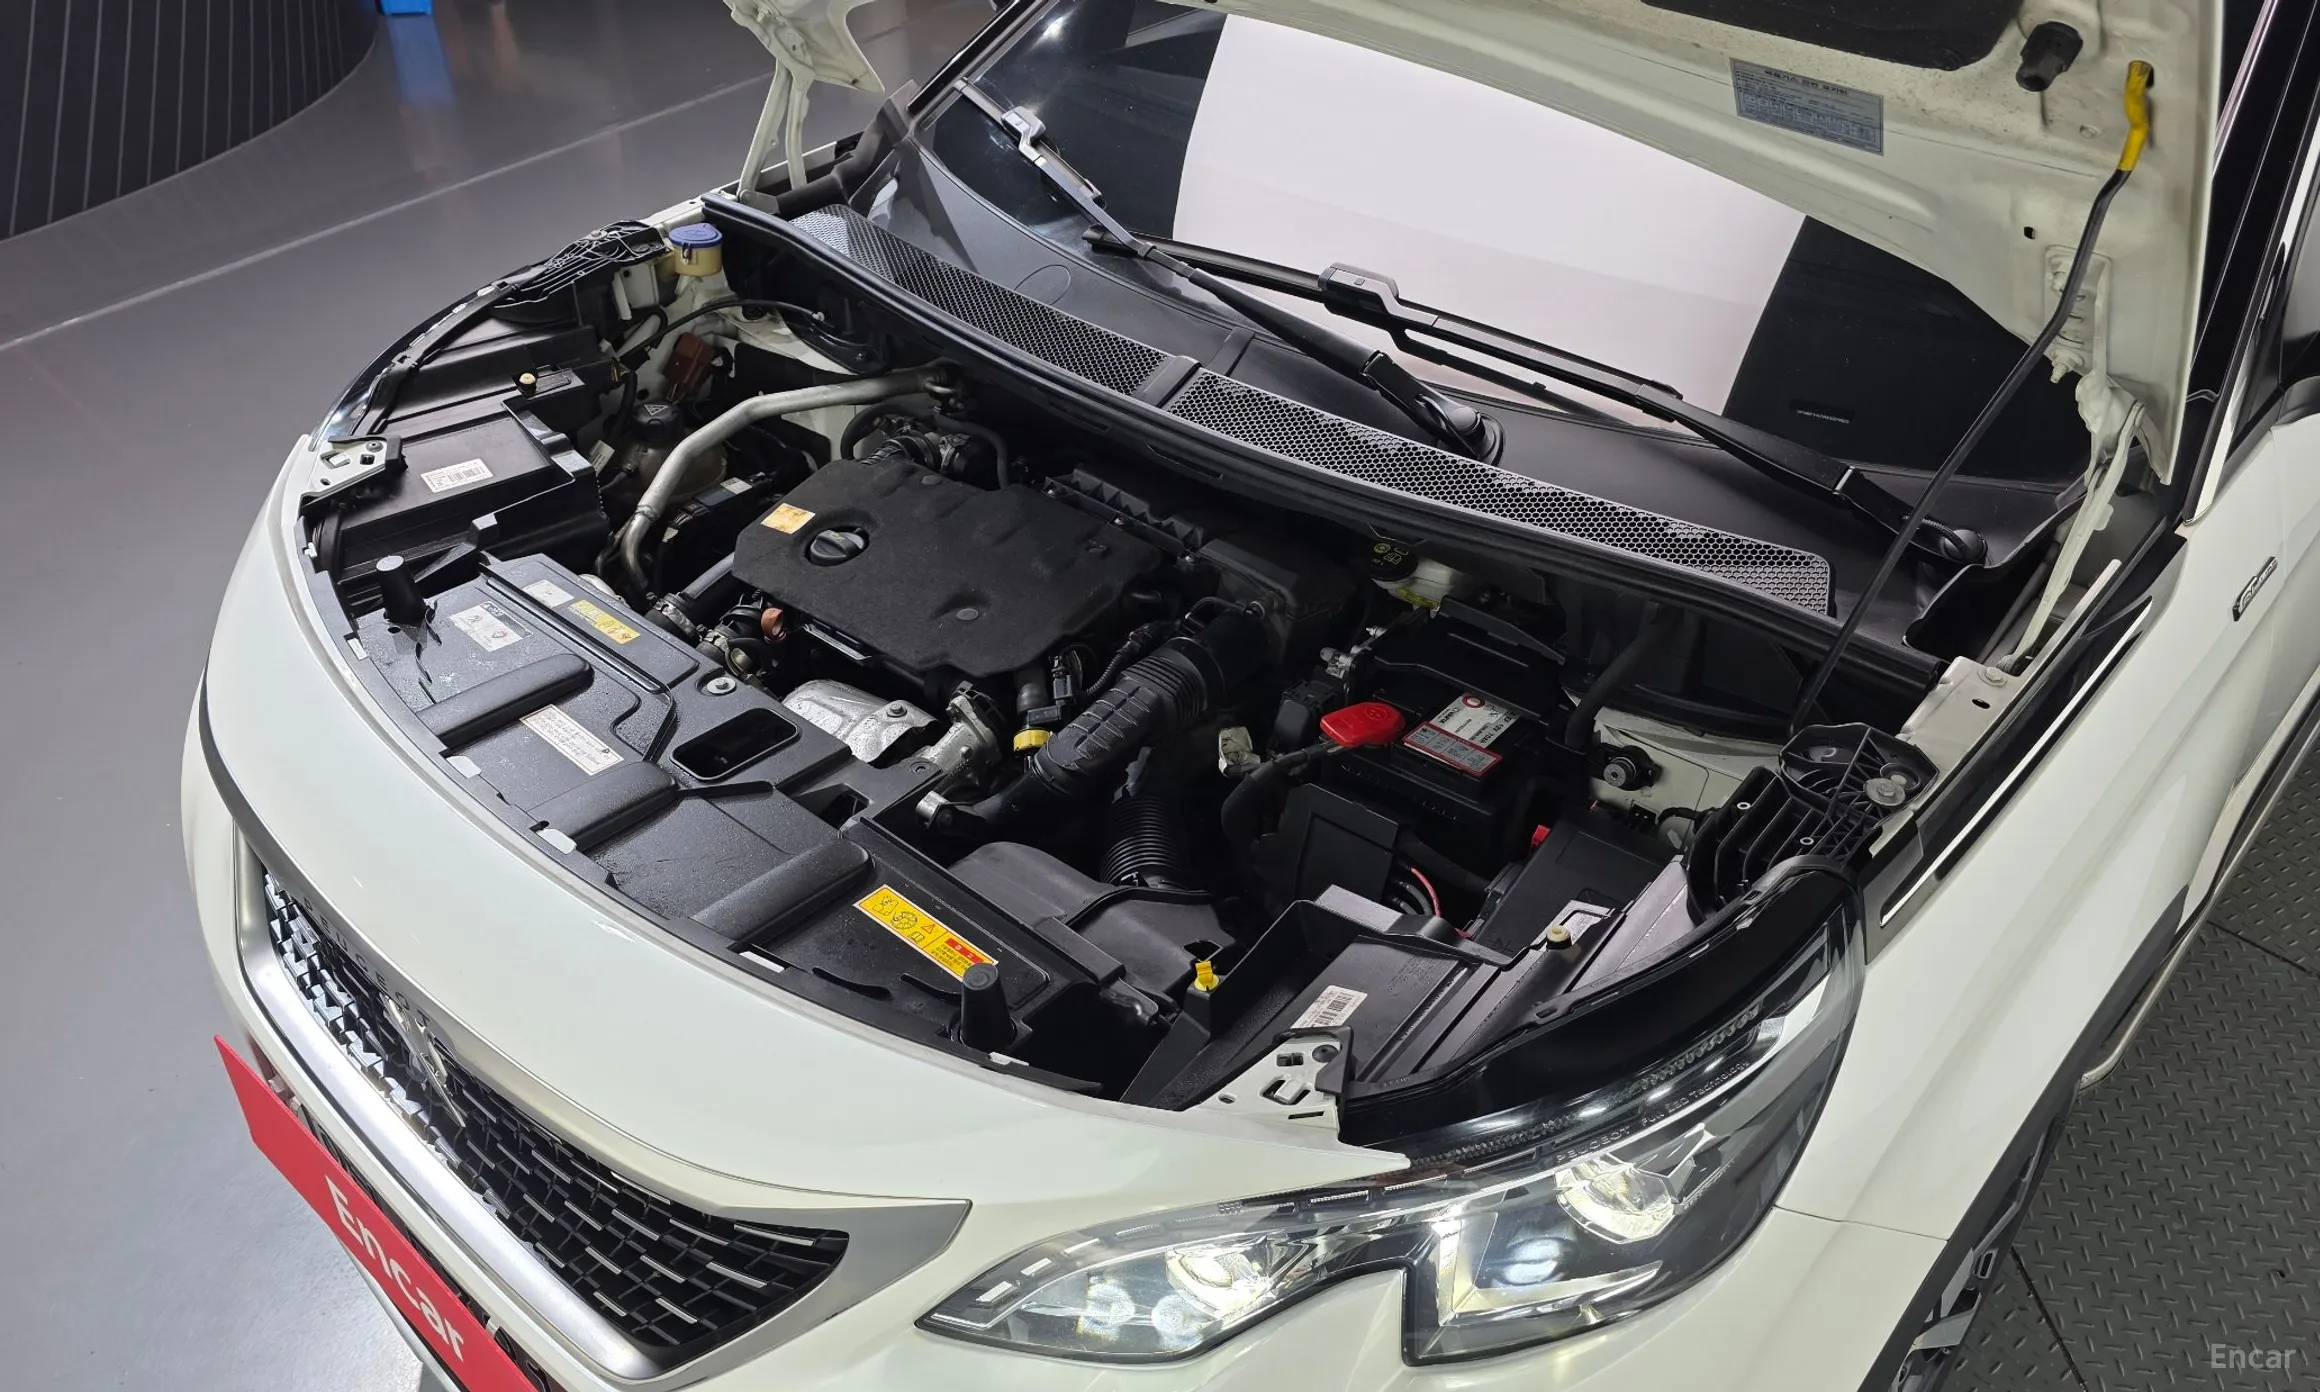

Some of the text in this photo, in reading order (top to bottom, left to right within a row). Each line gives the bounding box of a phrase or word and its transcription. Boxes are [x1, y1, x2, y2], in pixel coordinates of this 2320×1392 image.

[303, 896, 431, 1028] PEUGEOT
[1556, 1125, 1630, 1162] PEUGEOT
[325, 1174, 464, 1363] Encar
